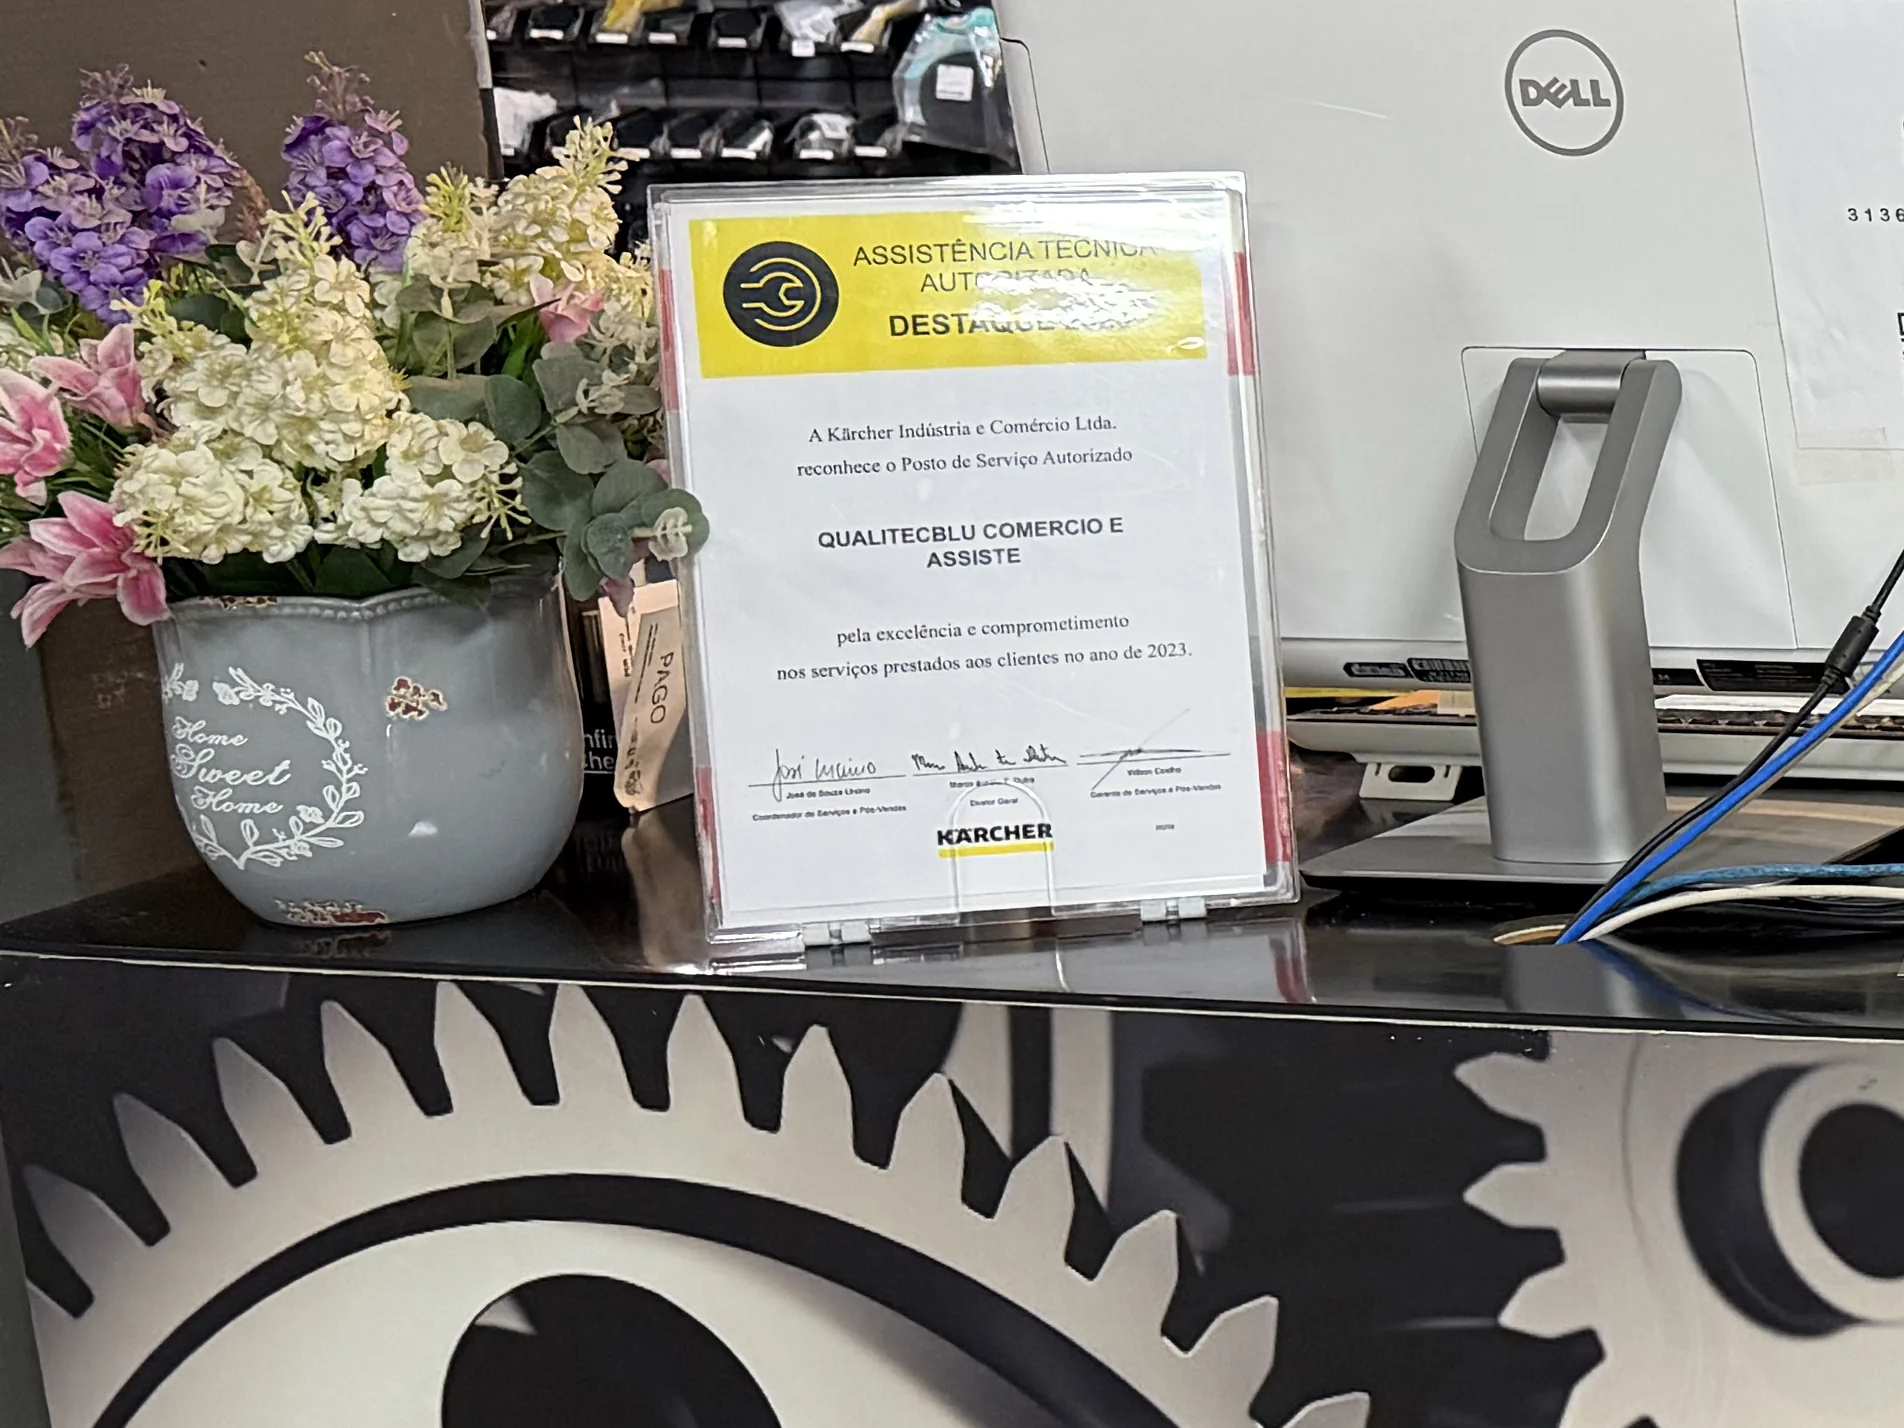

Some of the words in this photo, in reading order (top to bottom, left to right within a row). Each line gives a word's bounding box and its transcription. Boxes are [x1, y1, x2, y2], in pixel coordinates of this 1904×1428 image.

[1519, 76, 1611, 109] DELL
[853, 238, 1032, 267] ASSISTÊNCIA
[808, 428, 823, 443] A
[827, 425, 893, 442] Kärcher
[899, 421, 971, 439] Indústria
[976, 425, 985, 436] e
[990, 418, 1070, 435] Comércio
[1075, 415, 1117, 432] Ltda.
[797, 458, 881, 477] reconhece
[886, 462, 896, 473] o
[901, 455, 947, 472] Posto
[952, 453, 971, 470] de
[976, 451, 1038, 471] Serviço
[1043, 447, 1133, 465] Autorizado
[818, 524, 976, 549] QUALITECBLU
[983, 518, 1103, 540] COMERCIO
[1110, 517, 1124, 533] E
[927, 547, 1021, 569] ASSISTE
[836, 627, 871, 647] pela
[876, 623, 962, 642] excelência
[967, 625, 977, 636] e
[981, 614, 1129, 638] comprometimento
[777, 666, 806, 681] nos
[811, 660, 878, 679] serviços
[883, 657, 961, 678] prestados
[965, 655, 992, 670] aos
[998, 651, 1060, 669] clientes
[1064, 651, 1084, 663] no
[1089, 649, 1119, 662] ano
[1123, 645, 1142, 660] de
[1147, 642, 1192, 659] 2023.
[649, 651, 675, 725] PAGO
[171, 716, 248, 746] Home
[170, 743, 291, 786] Sweet
[190, 785, 283, 814] Home
